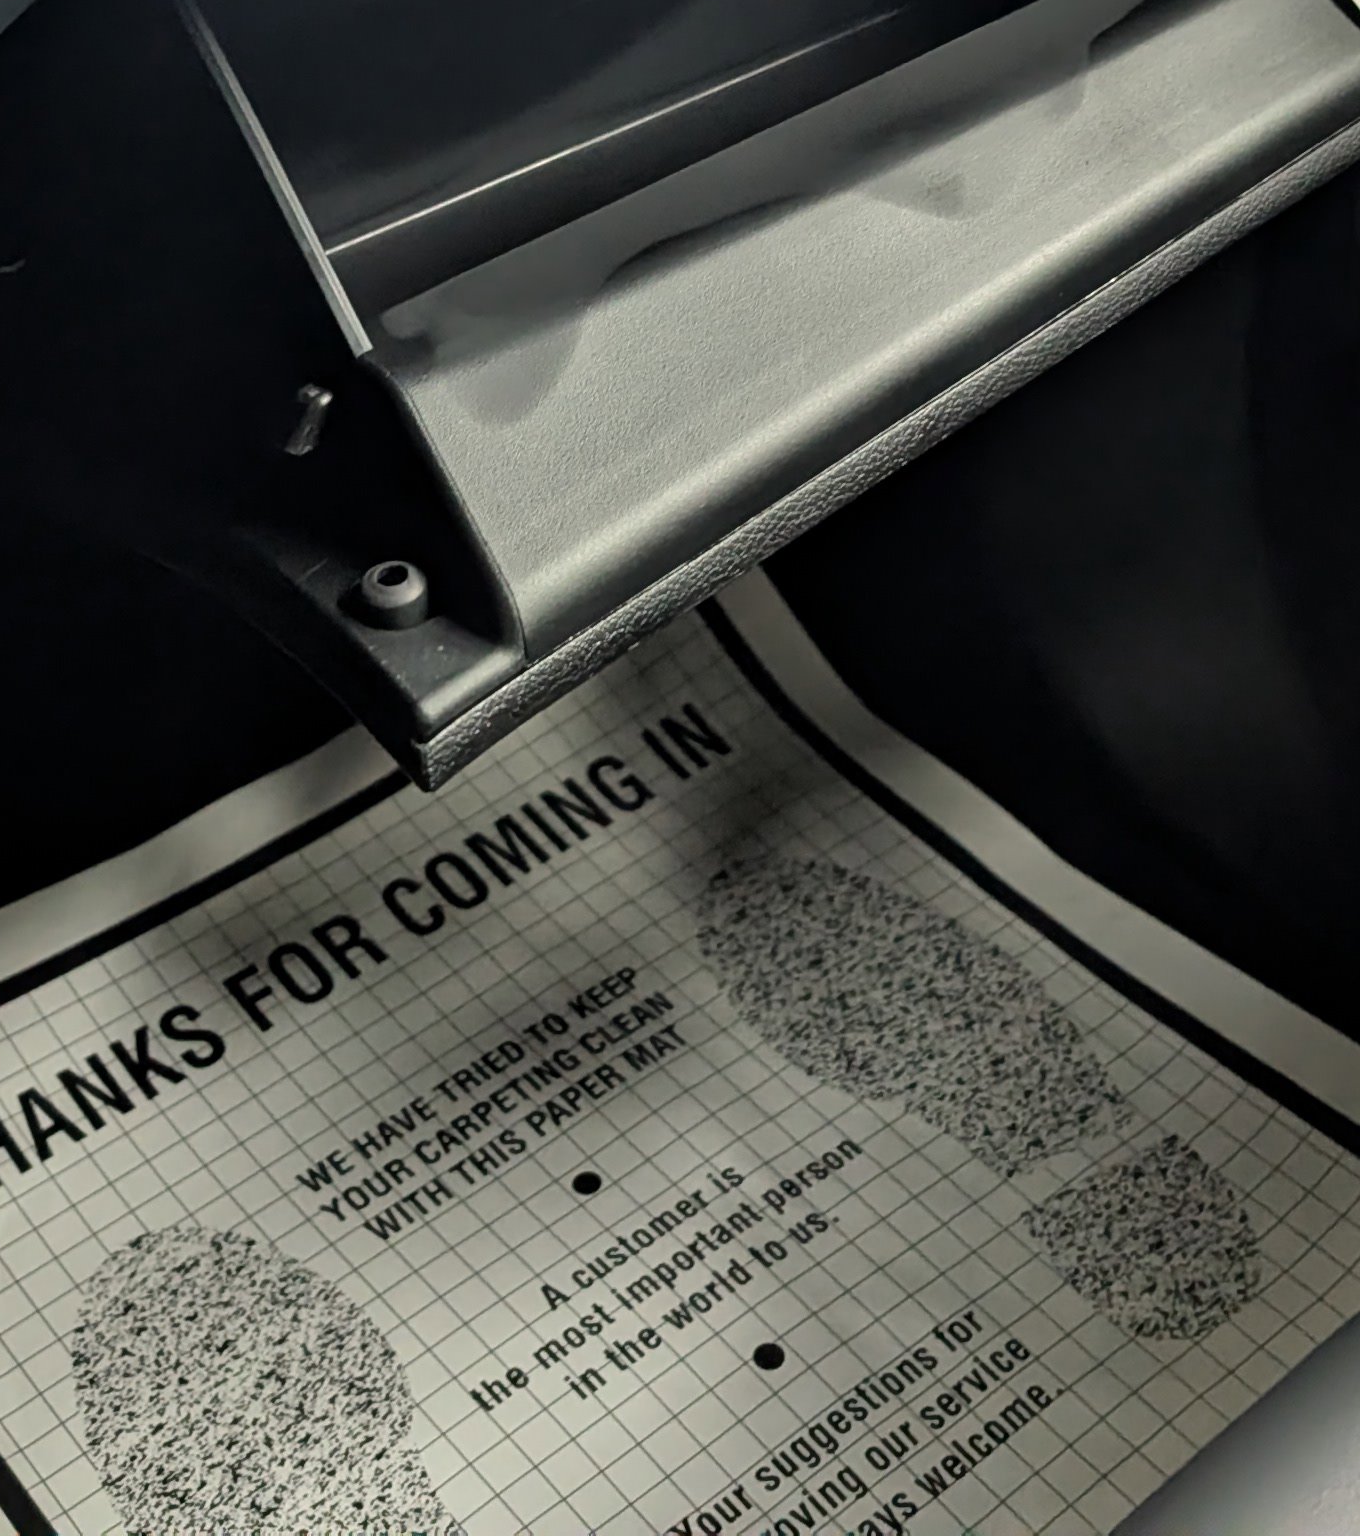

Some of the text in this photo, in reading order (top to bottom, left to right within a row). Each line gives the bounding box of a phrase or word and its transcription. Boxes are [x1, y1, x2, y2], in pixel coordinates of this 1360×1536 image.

[222, 912, 388, 1034] FOR
[380, 752, 656, 938] COMING
[641, 702, 734, 780] IN
[296, 966, 637, 1192] WE HAVE TRIED TO KEEP
[319, 991, 675, 1223] YOUR CARPETING CLEAN
[362, 1024, 688, 1241] WITH THIS PAPER MAT
[470, 1138, 863, 1412] the most important person
[539, 1165, 744, 1311] A customer is
[563, 1210, 841, 1401] in the world to us.
[666, 1307, 987, 1536] Your suggestions for
[863, 1421, 922, 1472] our
[920, 1336, 1033, 1431] service
[914, 1381, 1066, 1501] welcome.
